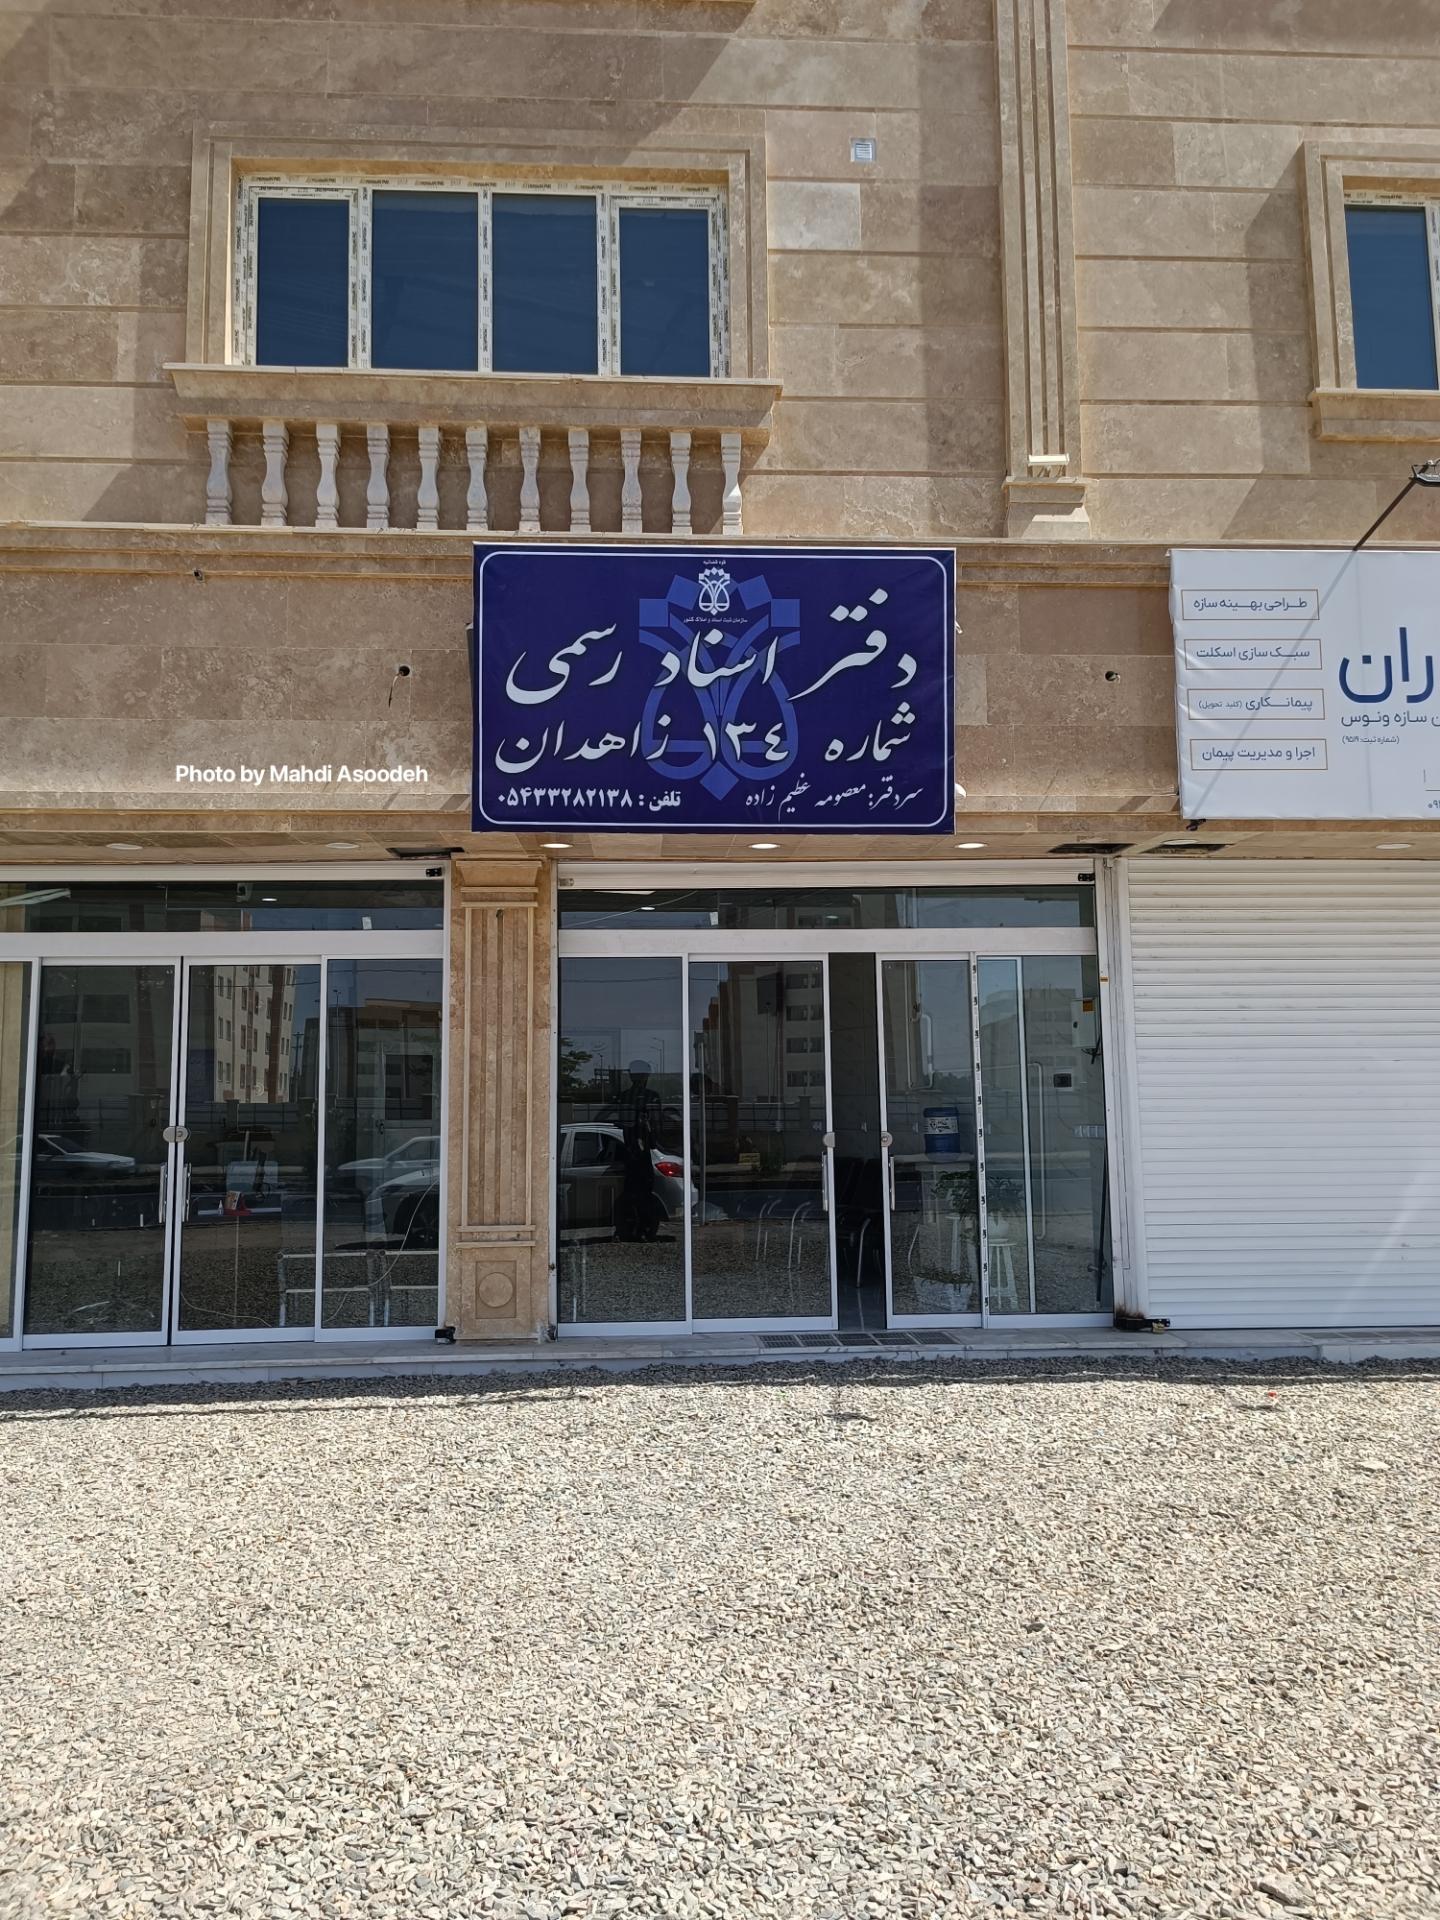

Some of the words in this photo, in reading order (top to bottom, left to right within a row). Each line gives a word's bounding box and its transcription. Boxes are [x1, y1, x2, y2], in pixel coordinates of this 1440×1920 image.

[1193, 597, 1218, 612] سازه
[1220, 598, 1263, 612] بهینه
[1264, 597, 1308, 611] طراحی
[787, 587, 918, 701] دفتر
[1196, 646, 1236, 658] اسکلت
[653, 627, 779, 689] اسناد
[1238, 646, 1268, 661] سازی
[1269, 646, 1310, 661] سبک
[505, 623, 623, 705] رسمی
[1245, 696, 1313, 712] پیمانکاری
[1341, 711, 1390, 727] ونوس
[1393, 710, 1427, 727] سازه
[823, 700, 917, 762] شماره
[494, 713, 672, 774] زاهدان
[1202, 746, 1235, 762] پیمان
[1237, 748, 1282, 761] مدیریت
[1285, 749, 1292, 761] و
[1295, 746, 1316, 761] اجرا
[745, 784, 775, 806] زاده
[777, 772, 812, 822] عظیم
[814, 783, 866, 807] معصومه
